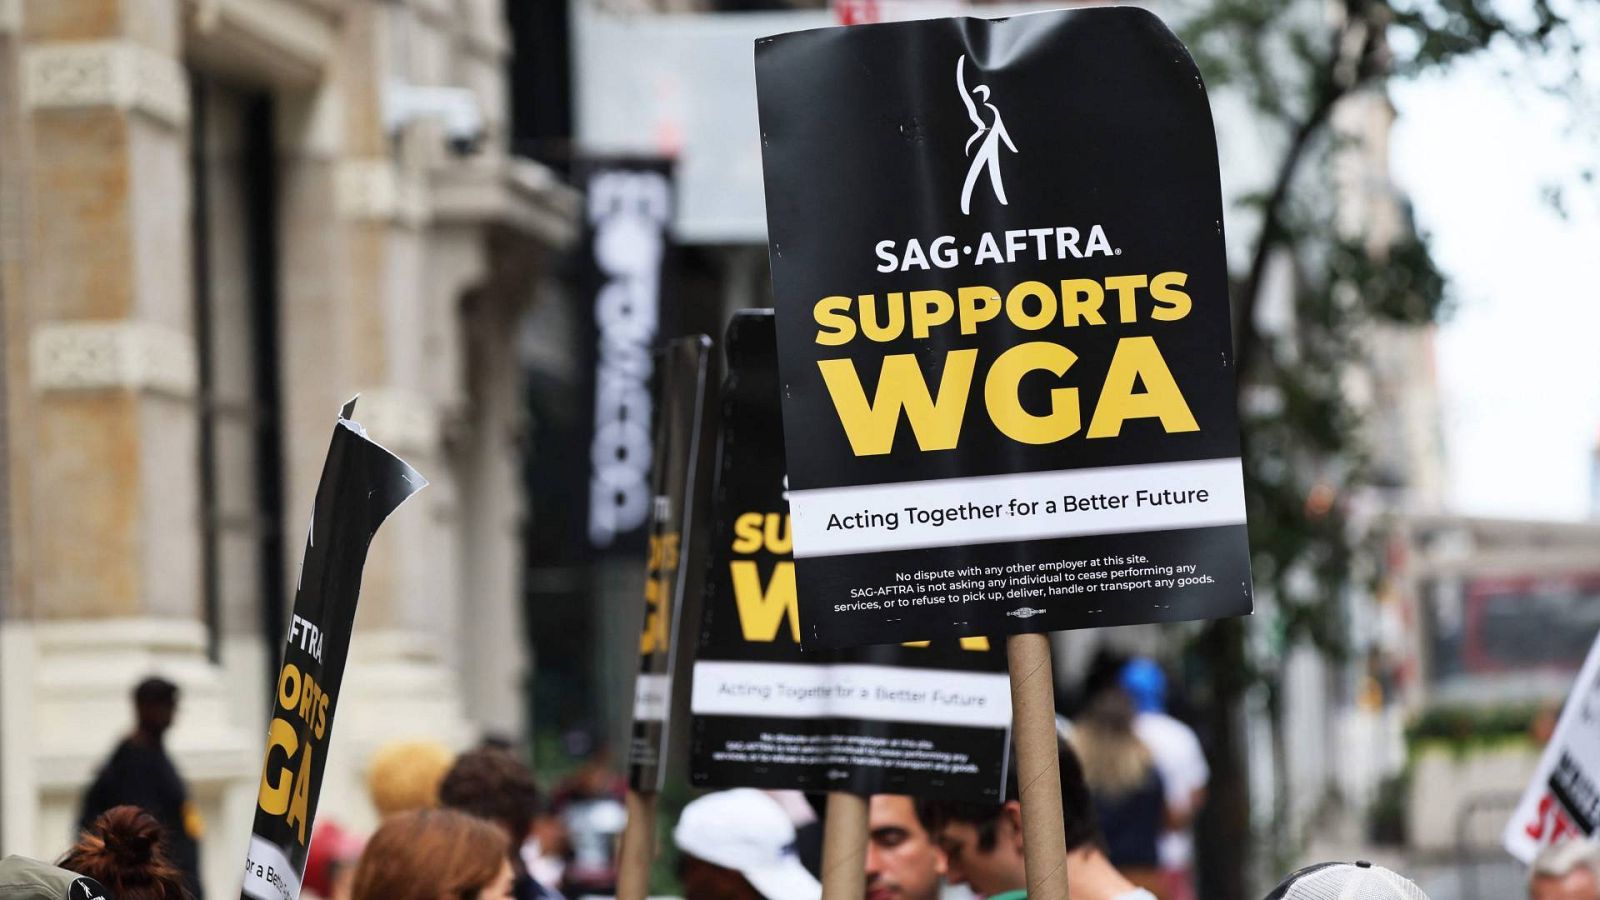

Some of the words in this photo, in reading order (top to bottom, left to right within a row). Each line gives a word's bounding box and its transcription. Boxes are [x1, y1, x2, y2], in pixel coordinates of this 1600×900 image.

[813, 271, 1193, 345] SUPPORTS
[817, 335, 1200, 457] WGA
[826, 509, 899, 531] Acting
[904, 502, 1003, 527] Together
[1008, 498, 1039, 517] for
[1046, 500, 1057, 514] a
[1064, 494, 1129, 513] Better
[1136, 489, 1209, 507] Future
[850, 584, 914, 598] SAG-AFTRA
[916, 583, 925, 593] is
[928, 582, 947, 593] not
[949, 579, 985, 593] asking
[988, 579, 1007, 590] any
[1010, 572, 1062, 586] individual
[1064, 573, 1075, 583] to
[1078, 571, 1107, 582] cease
[1111, 565, 1173, 581] performing
[1176, 564, 1197, 576] any
[896, 572, 911, 582] No
[913, 569, 955, 582] dispute
[957, 566, 982, 577] with
[985, 566, 1003, 577] any
[1006, 563, 1036, 574] other
[1038, 559, 1087, 573] employer
[1090, 558, 1101, 567] at
[1103, 555, 1124, 566] this
[1126, 554, 1149, 565] site.
[834, 600, 881, 613] services,
[884, 600, 895, 609] or
[898, 598, 909, 608] to
[912, 595, 945, 607] refuse
[948, 594, 959, 604] to
[962, 590, 985, 604] pick
[988, 591, 1004, 602] up,
[1006, 585, 1046, 599] deliver,
[1048, 582, 1084, 596] handle
[1086, 583, 1097, 592] or
[1100, 578, 1152, 592] transport
[1155, 577, 1175, 589] any
[1177, 573, 1215, 588] goods.
